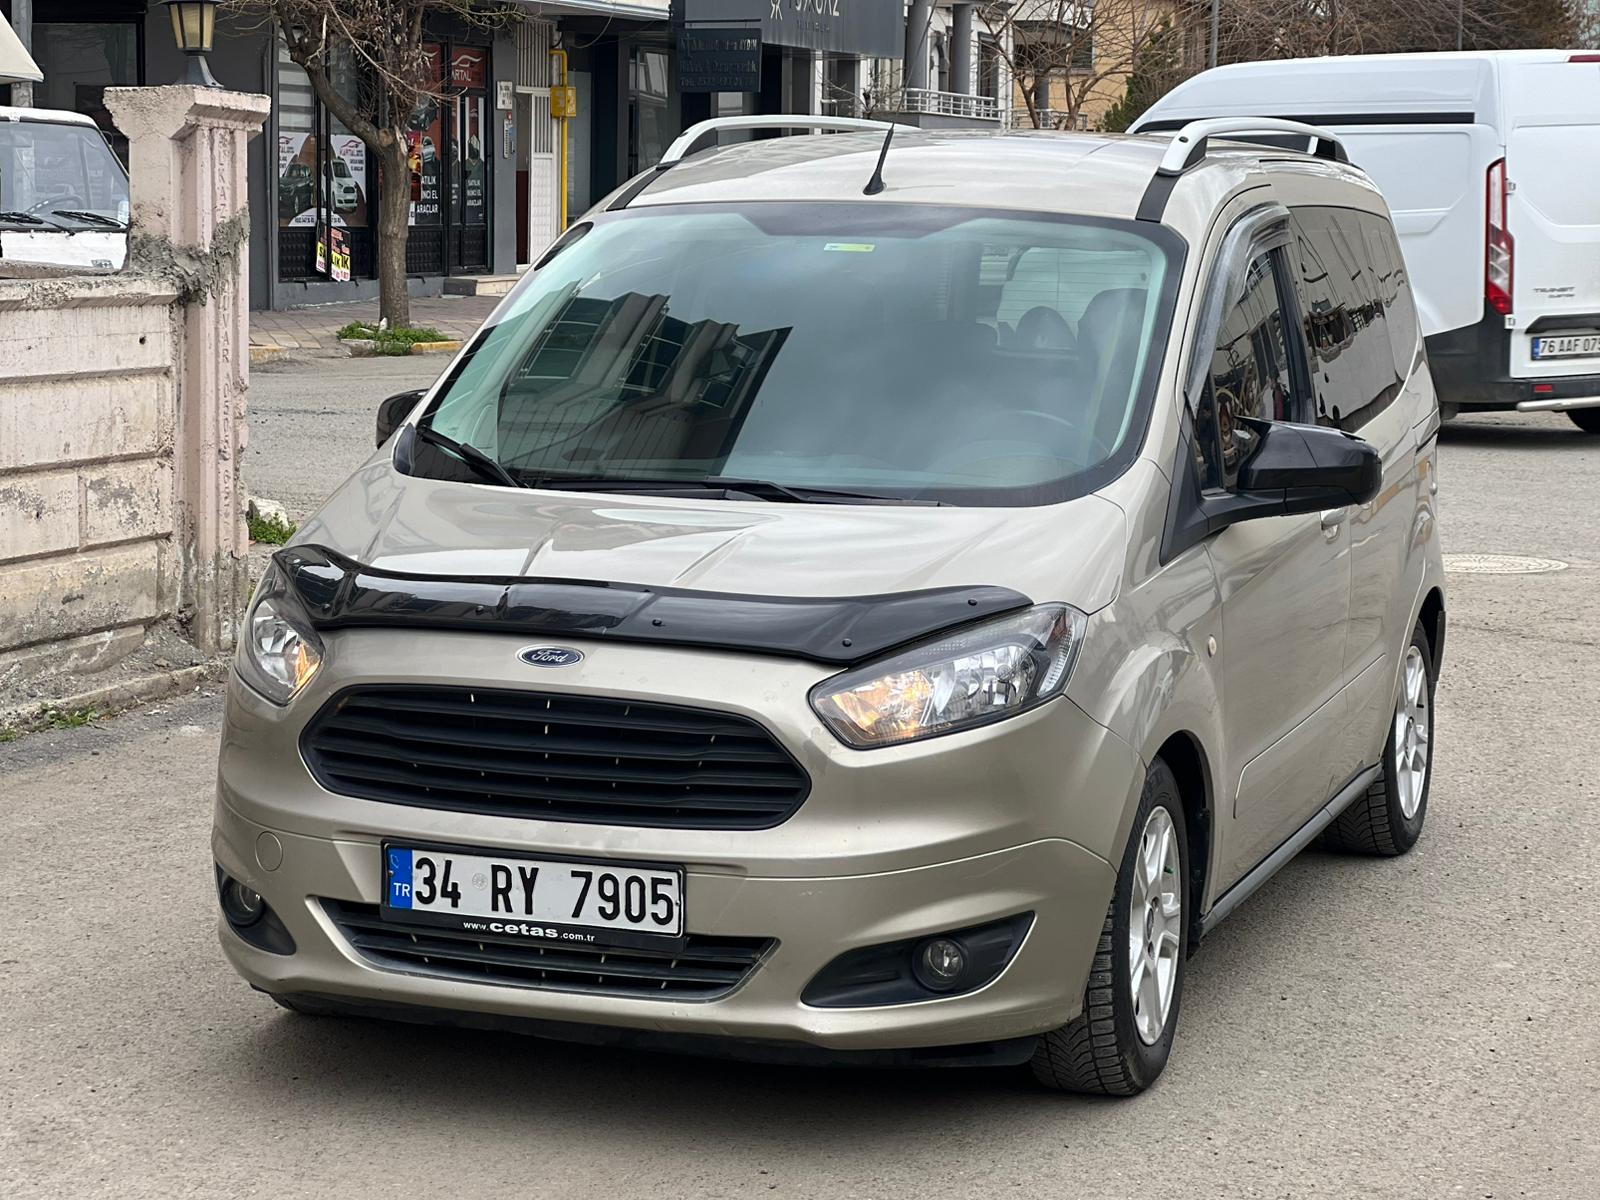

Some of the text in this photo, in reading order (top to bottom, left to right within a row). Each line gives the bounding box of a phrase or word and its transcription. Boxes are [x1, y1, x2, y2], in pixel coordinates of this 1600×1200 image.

[1541, 340, 1555, 353] 76
[1559, 339, 1580, 352] AAF
[531, 649, 569, 663] Ford
[393, 882, 411, 897] TR
[415, 857, 674, 926] 34 RY 7905
